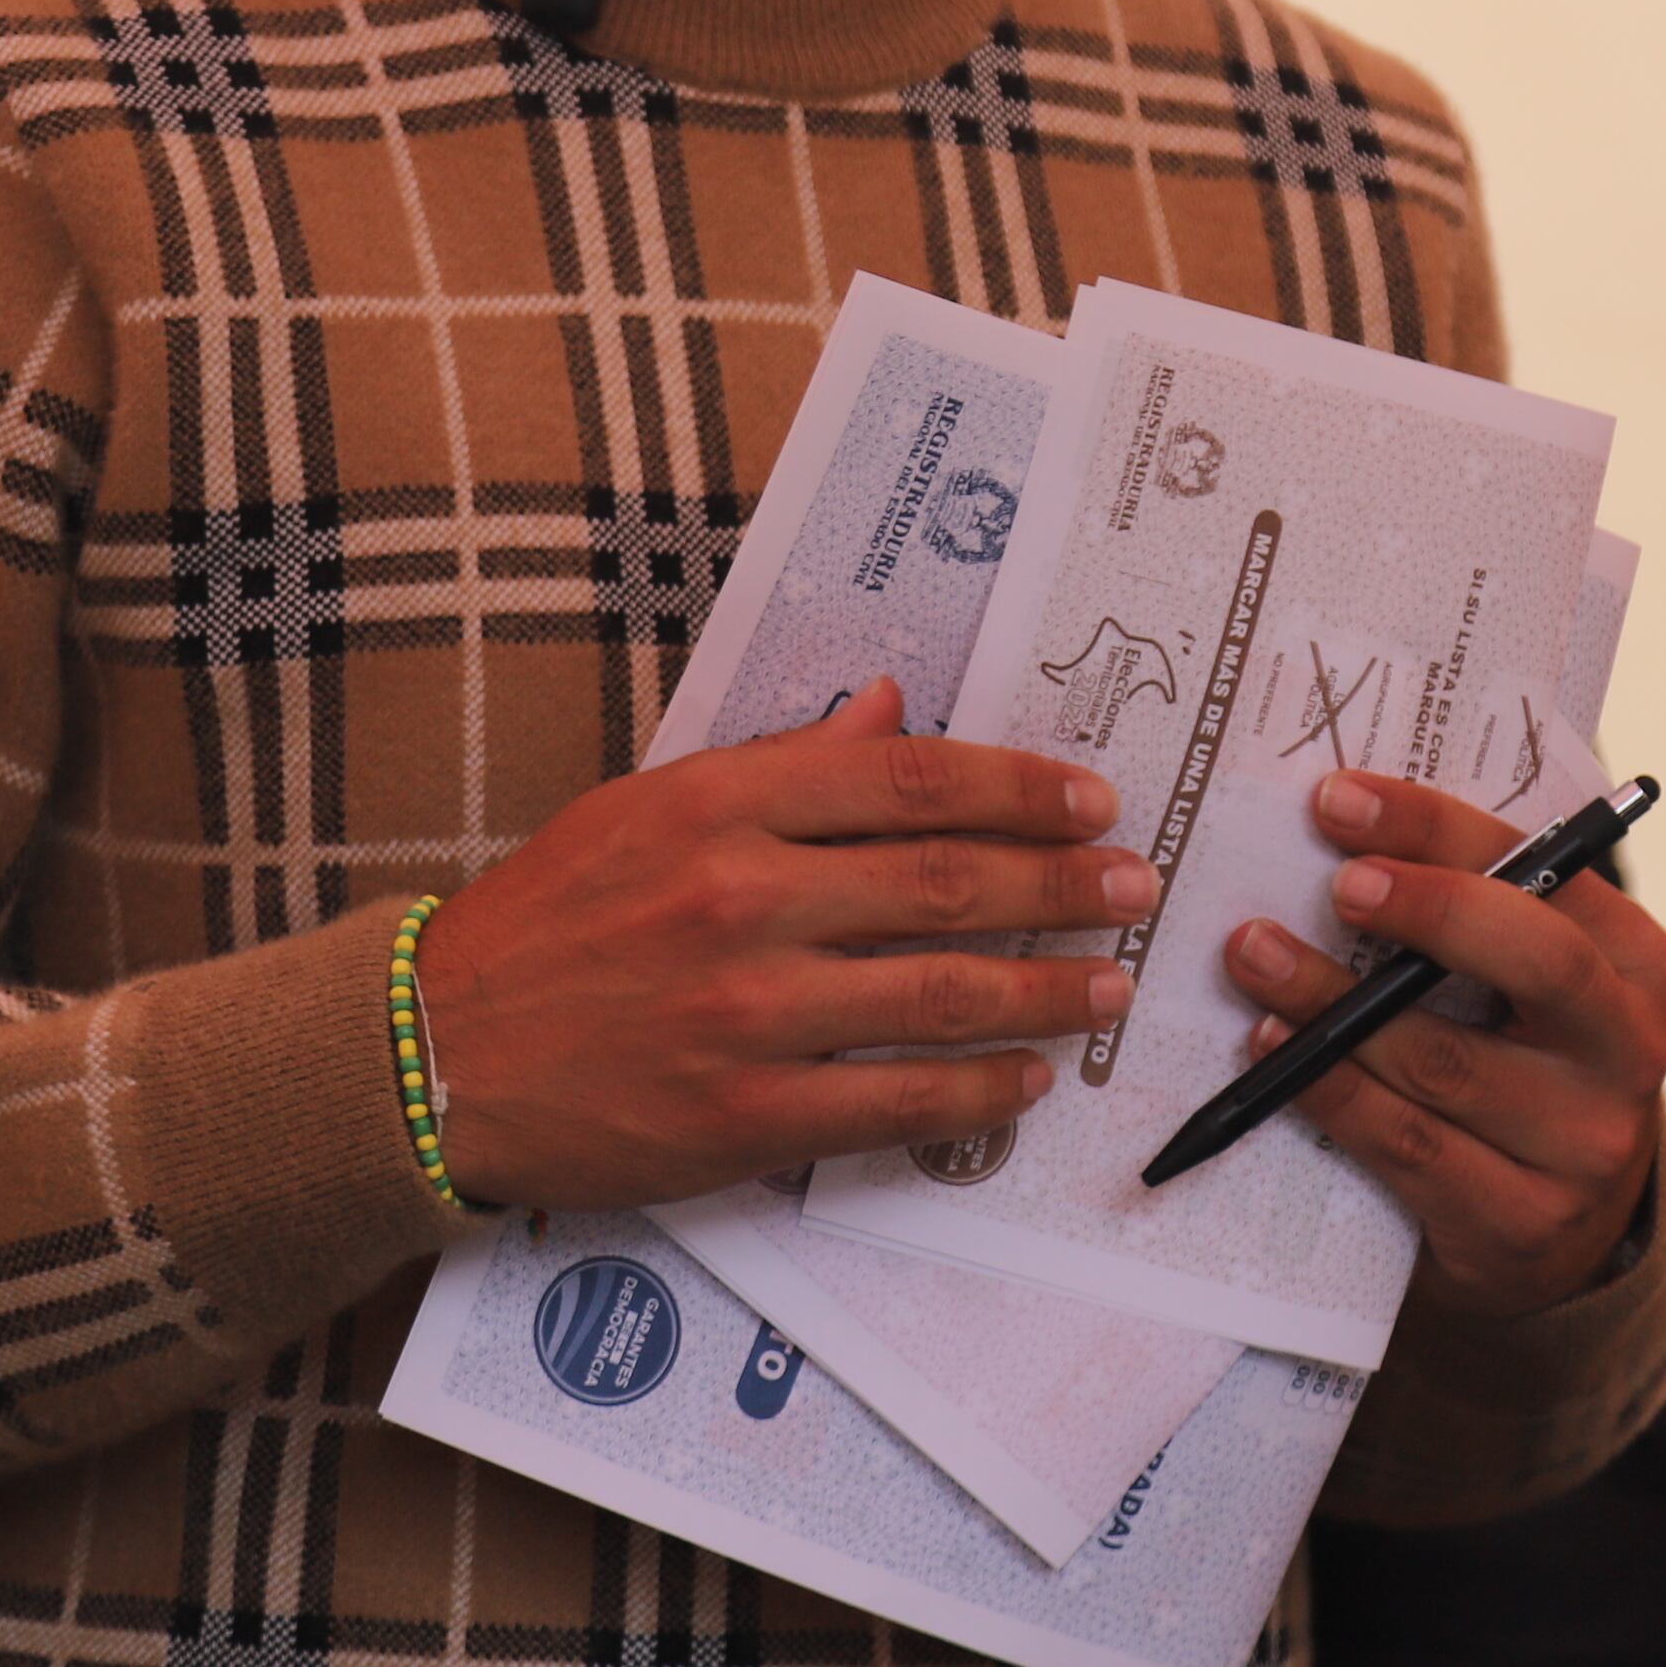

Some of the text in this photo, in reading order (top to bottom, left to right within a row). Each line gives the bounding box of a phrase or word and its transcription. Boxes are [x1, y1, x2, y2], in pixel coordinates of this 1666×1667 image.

[1139, 364, 1161, 420] NACIONAL
[853, 391, 944, 585] NACIONAL DEL ESTADO CIVIL
[866, 397, 964, 591] REGISTRADURÍA
[1117, 366, 1175, 531] REGISTRADURÍA
[1229, 532, 1273, 639] MARCAR
[1054, 668, 1097, 743] 2023
[1085, 645, 1123, 728] Territoriales
[1094, 647, 1141, 750] Elecciones
[1212, 644, 1242, 698] MÁS
[1253, 652, 1285, 736] NO PREFERENTE
[1411, 661, 1442, 755] MARQUE
[1423, 567, 1487, 780] SI SU LISTA ES CON
[1199, 703, 1225, 737] DE
[1180, 741, 1212, 793] UNA
[1154, 799, 1193, 866] LISTA
[584, 1276, 638, 1387] DEMOCRACIA
[615, 1297, 660, 1389] GARANTES
